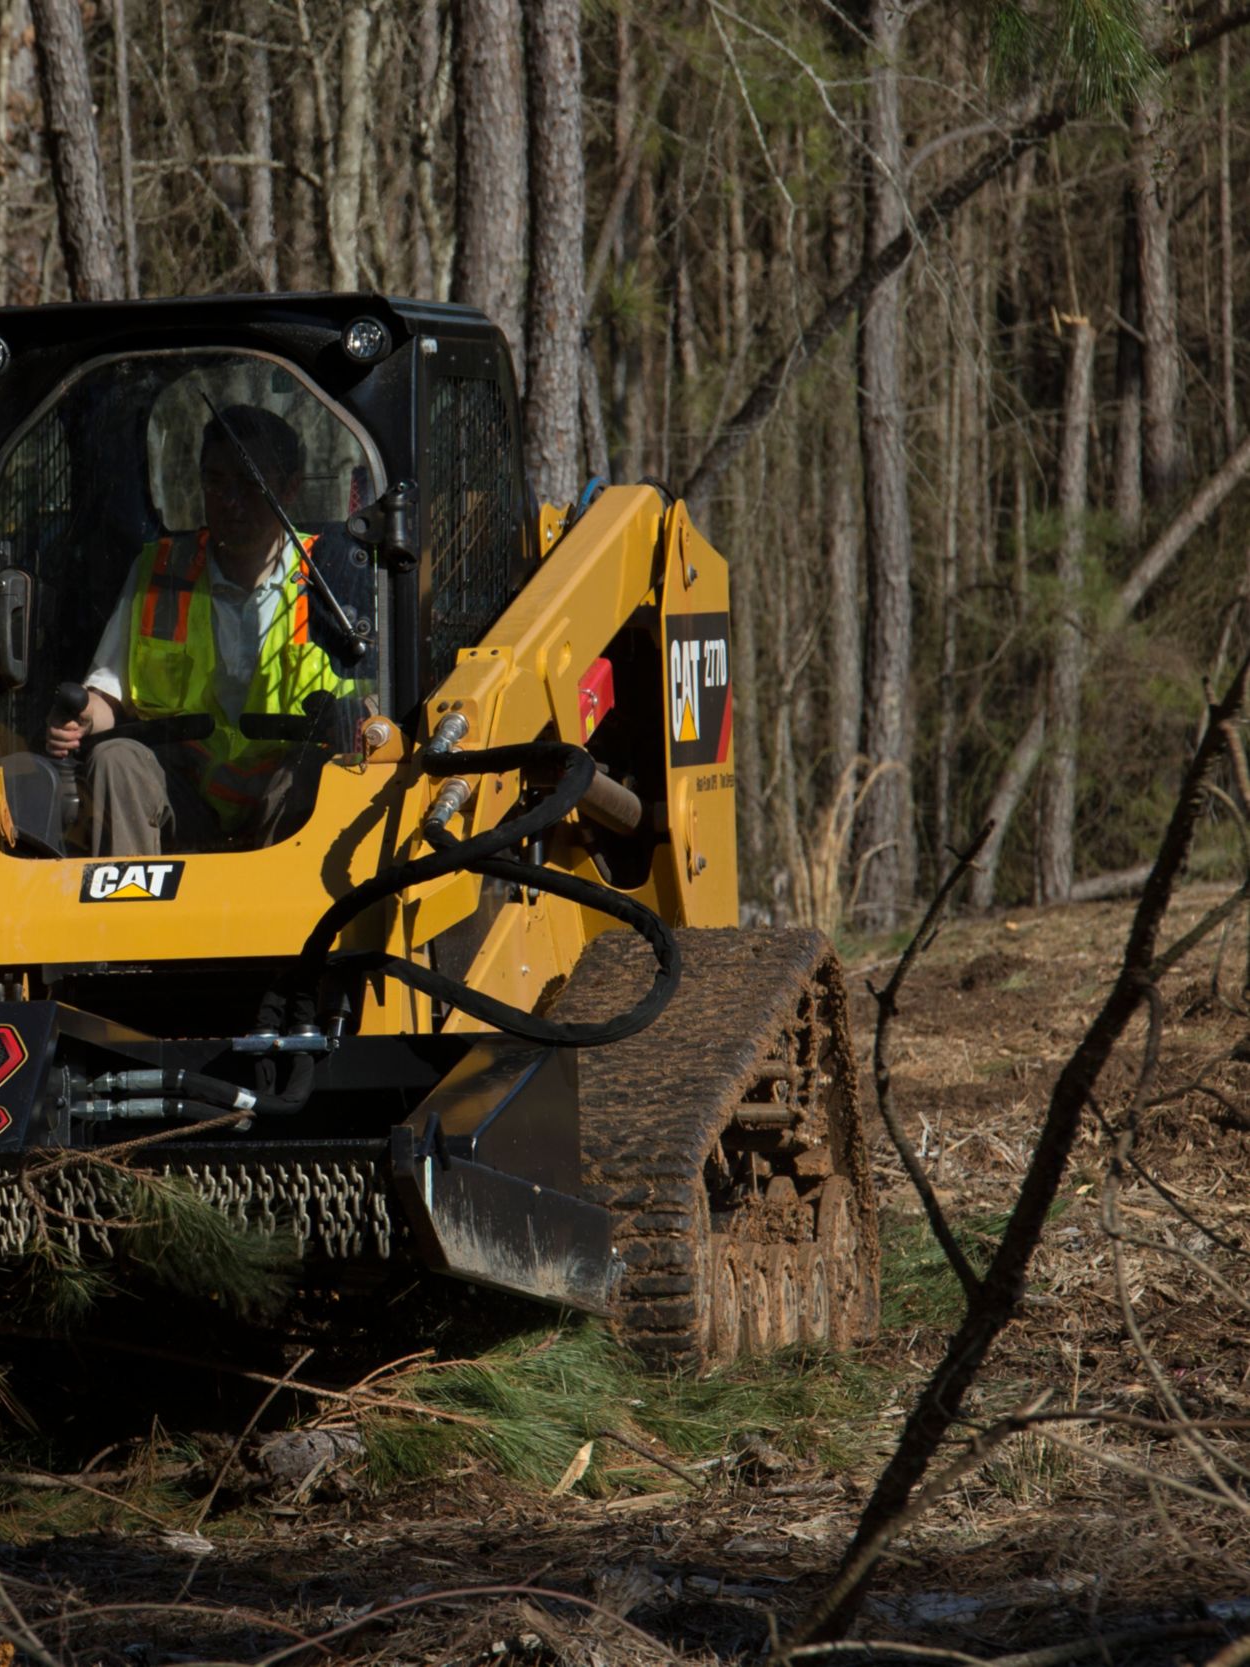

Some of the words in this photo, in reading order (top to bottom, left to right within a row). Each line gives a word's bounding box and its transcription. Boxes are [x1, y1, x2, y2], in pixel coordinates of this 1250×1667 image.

[671, 640, 700, 742] CAT
[704, 639, 727, 687] 277D
[90, 865, 173, 898] CAT
